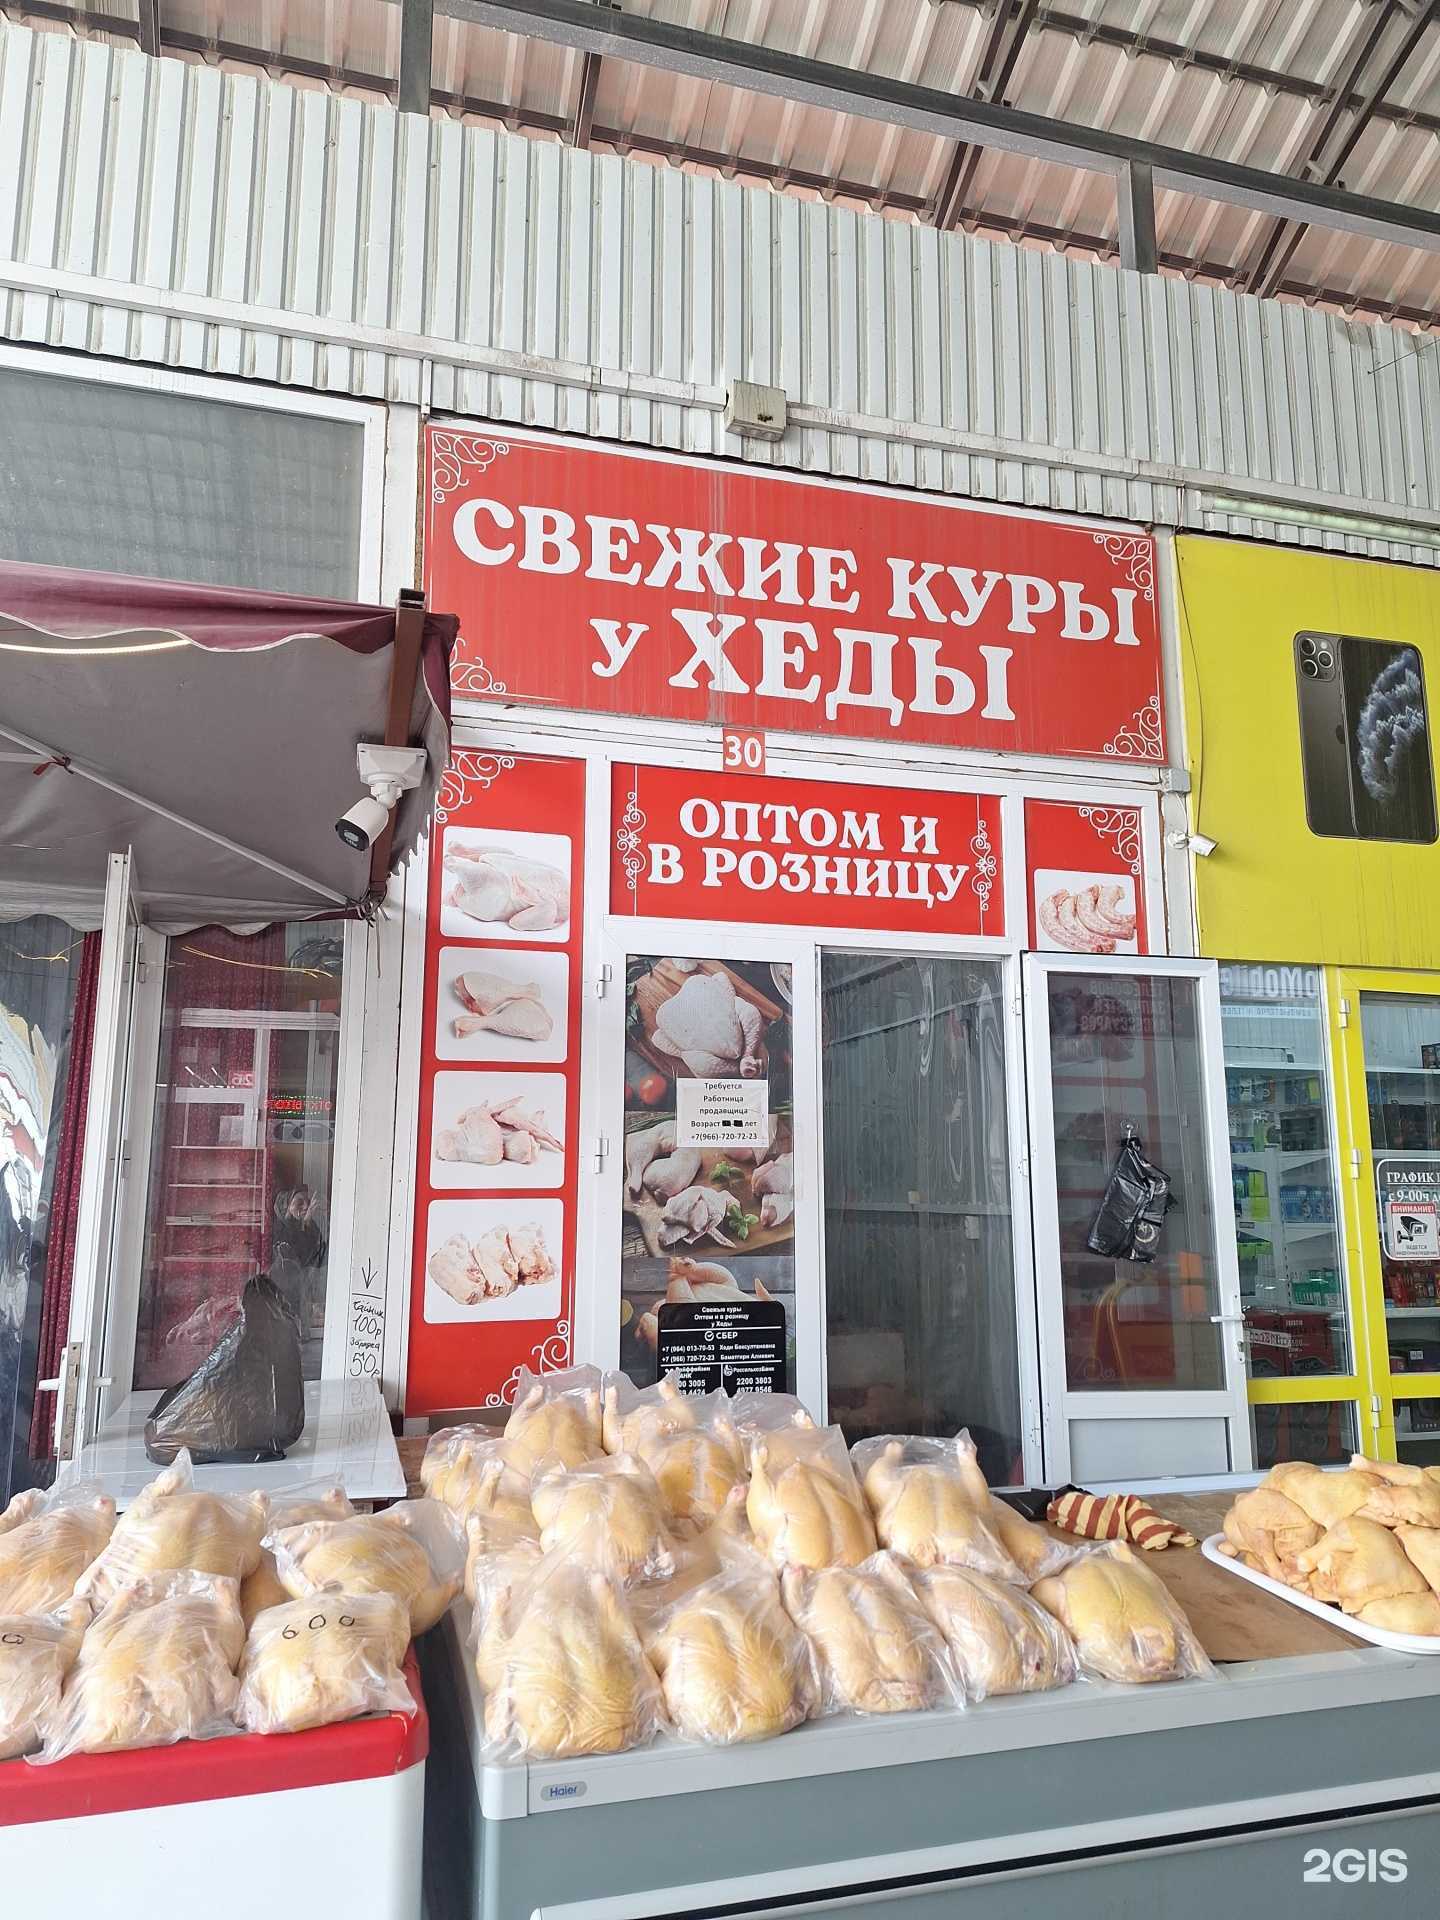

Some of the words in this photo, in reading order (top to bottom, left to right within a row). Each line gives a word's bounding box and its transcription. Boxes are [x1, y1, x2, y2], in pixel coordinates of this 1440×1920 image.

[453, 498, 860, 615] СВЕЖИЕ
[887, 556, 1142, 646] КУРЫ
[669, 608, 1017, 727] ХЕДЫ
[725, 736, 763, 768] 30
[679, 798, 895, 852] ОПТОМ
[902, 815, 940, 855] И
[648, 843, 683, 886] В
[702, 850, 970, 910] РОЗНИЦУ
[704, 1082, 742, 1091] Требуется
[703, 1095, 744, 1103] Работница
[691, 1133, 757, 1141] +7(966)-720-72-23
[1386, 1172, 1434, 1183] ГРАФИК
[1397, 1190, 1430, 1202] 9-00ч
[1392, 1205, 1434, 1213] ВНИМАНИЕ!
[688, 1379, 706, 1388] 3005
[550, 1785, 577, 1797] Haier
